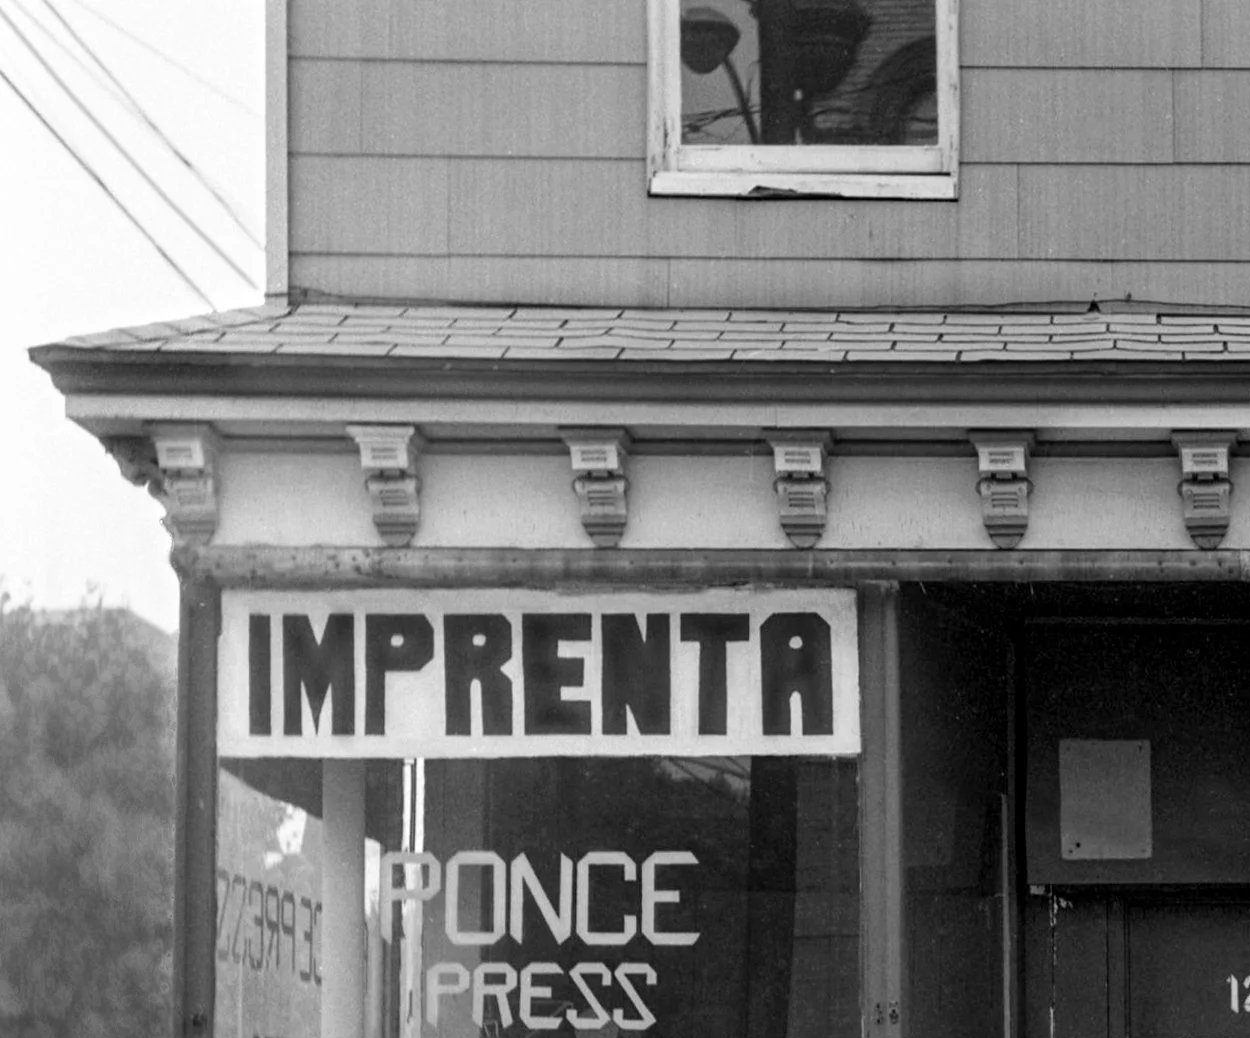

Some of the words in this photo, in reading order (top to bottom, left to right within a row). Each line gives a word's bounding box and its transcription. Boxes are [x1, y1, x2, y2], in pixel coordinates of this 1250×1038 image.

[249, 612, 834, 737] IMPRENTA
[380, 849, 701, 946] PONCE
[425, 961, 658, 1030] PRESS
